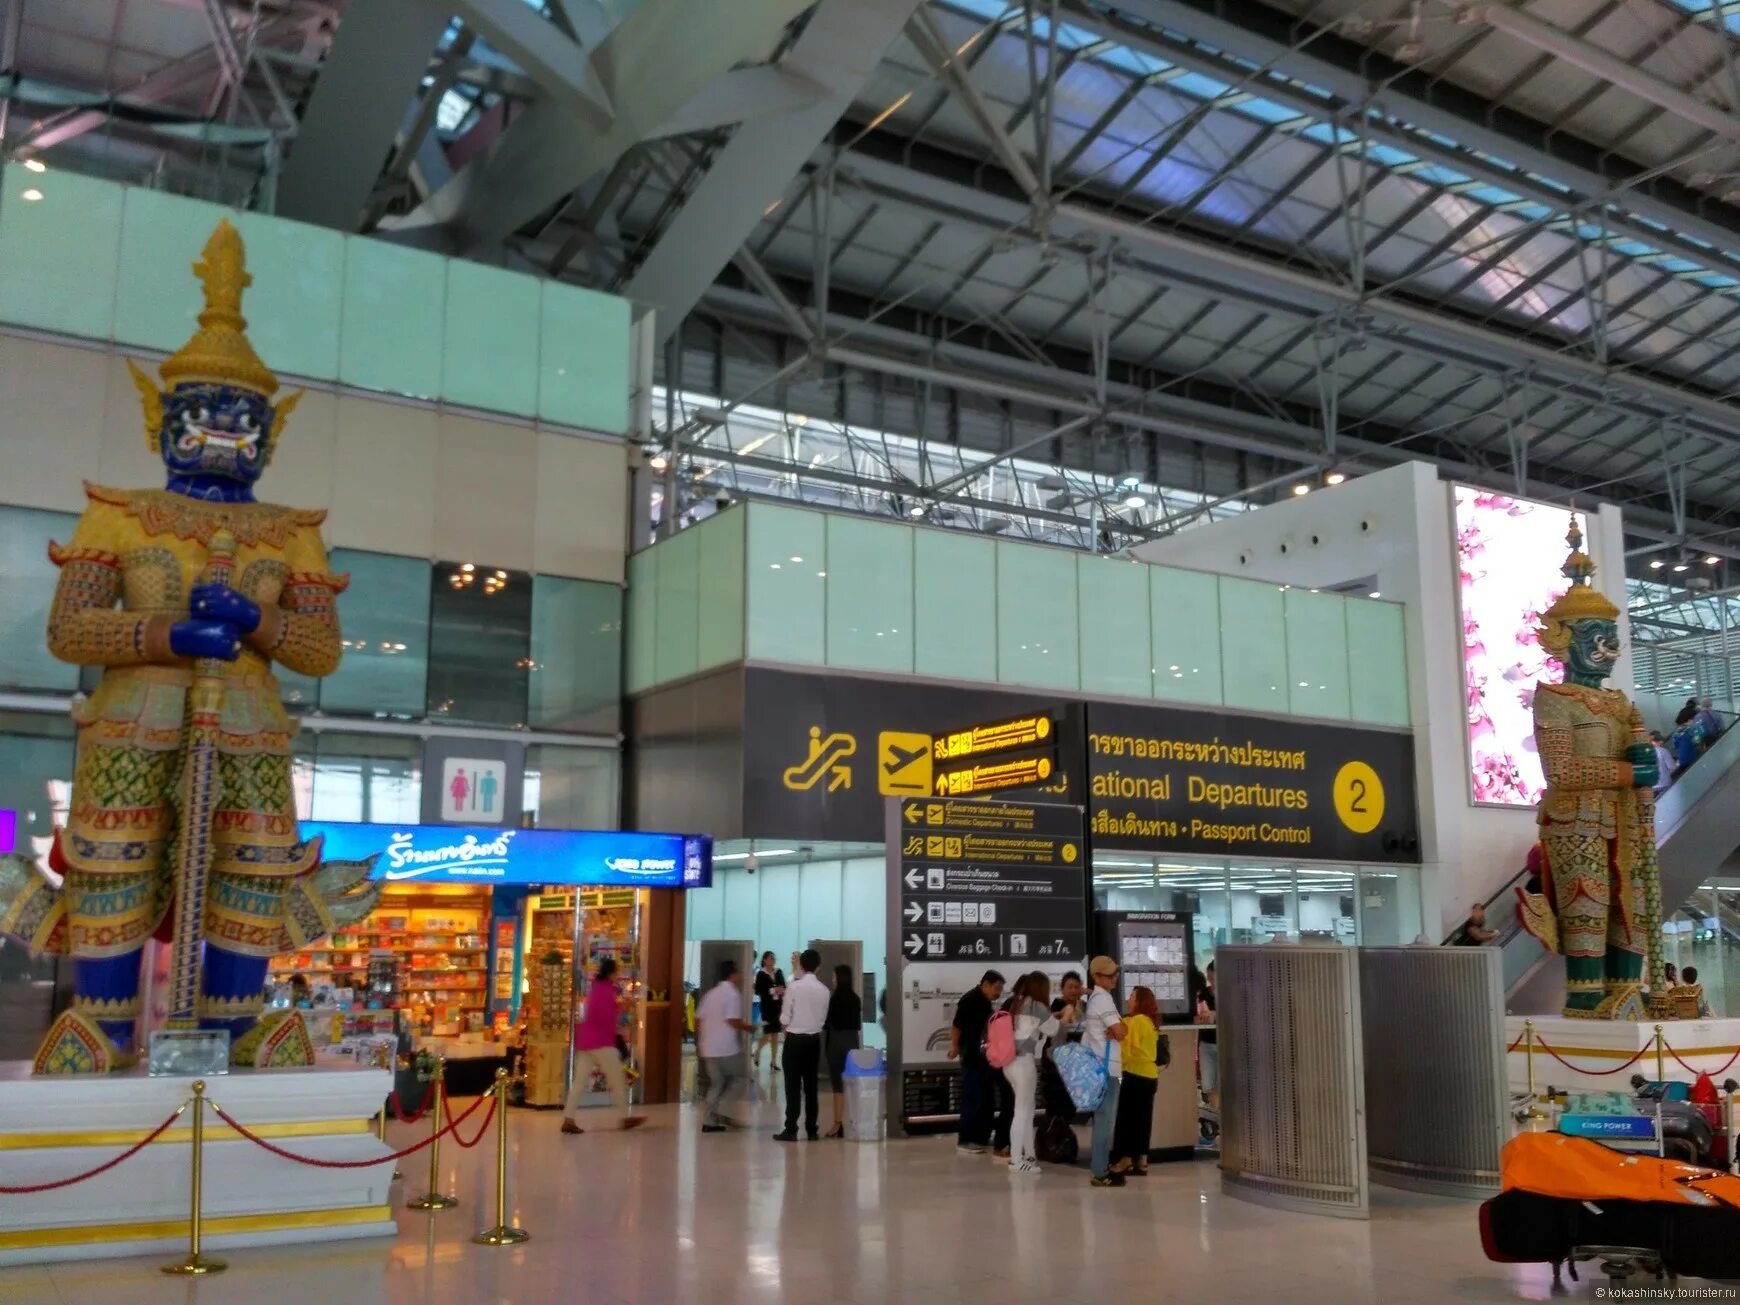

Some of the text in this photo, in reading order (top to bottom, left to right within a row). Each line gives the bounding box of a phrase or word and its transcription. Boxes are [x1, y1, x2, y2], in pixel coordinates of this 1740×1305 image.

[1092, 770, 1170, 800] ational
[1188, 775, 1309, 811] Departures
[1350, 779, 1367, 813] 2
[1191, 819, 1311, 844] Passport Control
[976, 938, 985, 954] 6
[1055, 939, 1064, 955] 7
